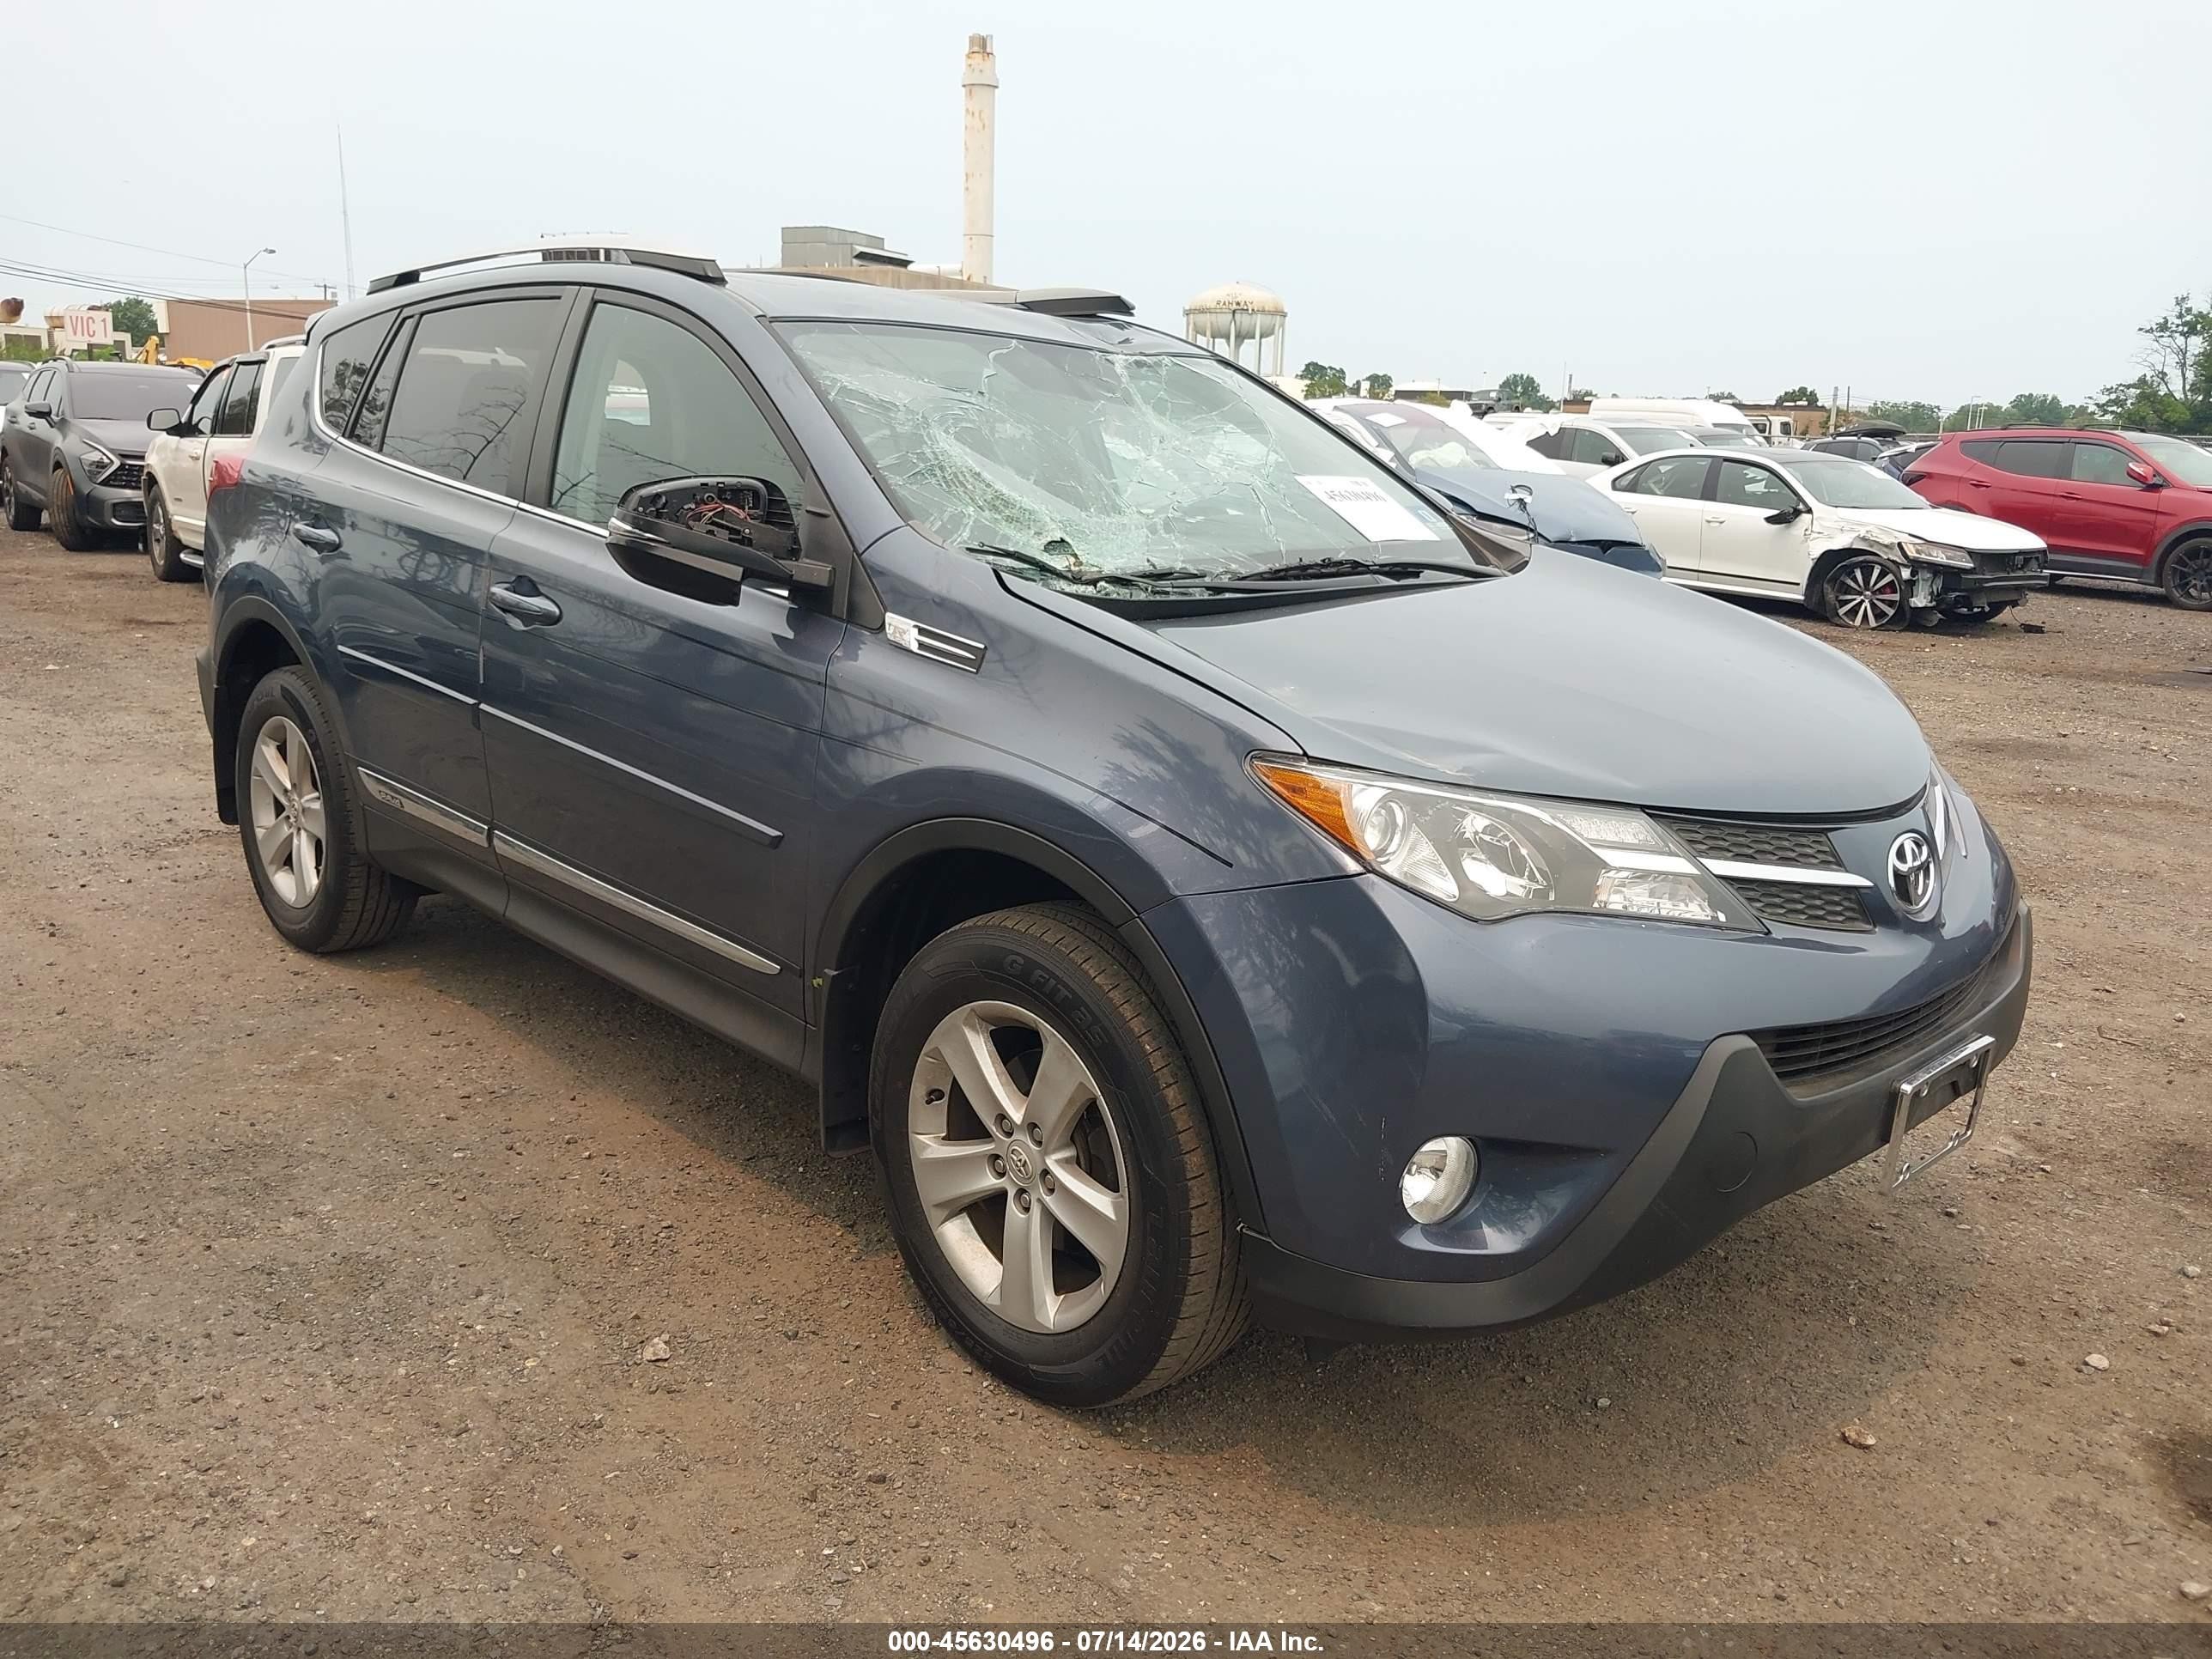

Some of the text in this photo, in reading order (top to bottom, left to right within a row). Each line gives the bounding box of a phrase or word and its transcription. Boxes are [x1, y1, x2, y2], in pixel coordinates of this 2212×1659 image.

[1216, 299, 1255, 308] RAHWAY
[70, 313, 109, 338] VIC 1
[1002, 954, 1025, 977] G
[1028, 969, 1076, 1002] FIT
